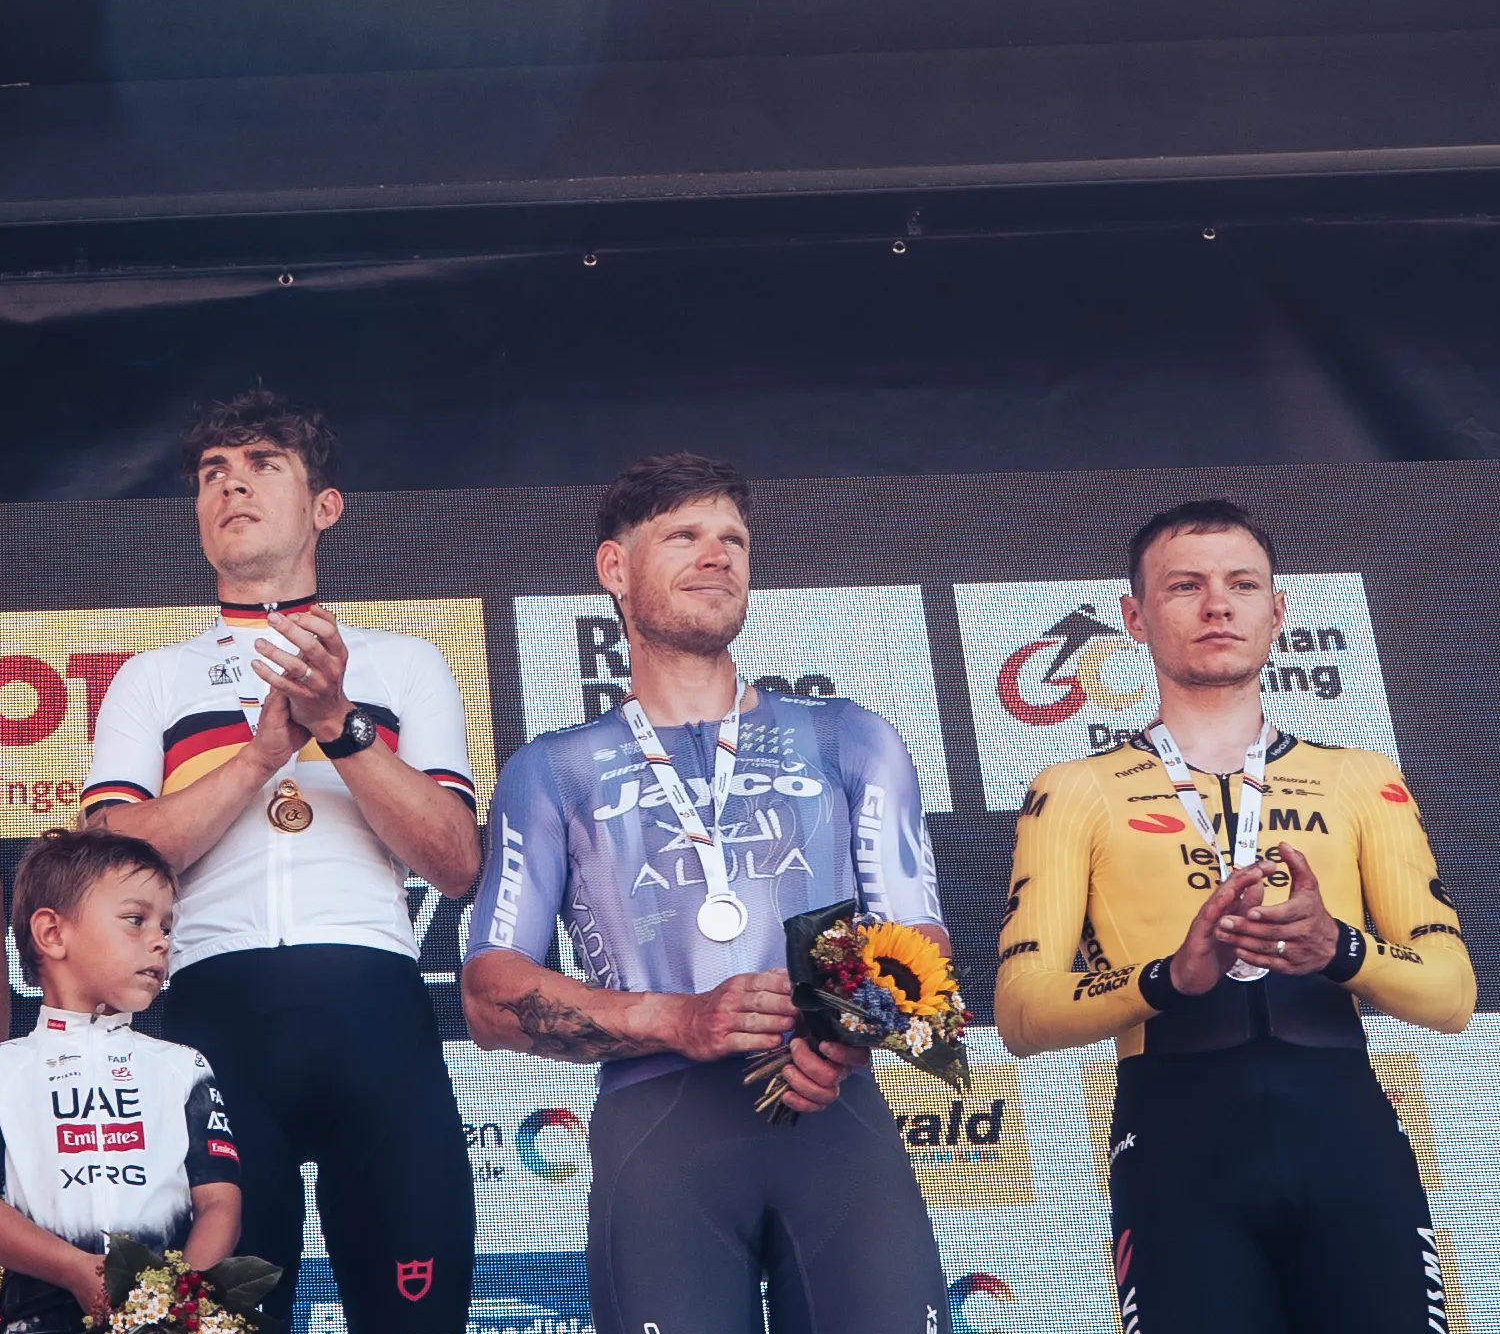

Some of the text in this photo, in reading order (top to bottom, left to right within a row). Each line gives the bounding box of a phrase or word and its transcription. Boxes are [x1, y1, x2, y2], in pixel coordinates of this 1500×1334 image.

[600, 761, 651, 781] GIAN
[593, 773, 824, 821] Jayco
[1212, 808, 1329, 835] VMA
[1087, 975, 1130, 998] COACH
[51, 1086, 142, 1120] UAE
[62, 1129, 139, 1147] Emirates
[59, 1164, 147, 1190] XRG
